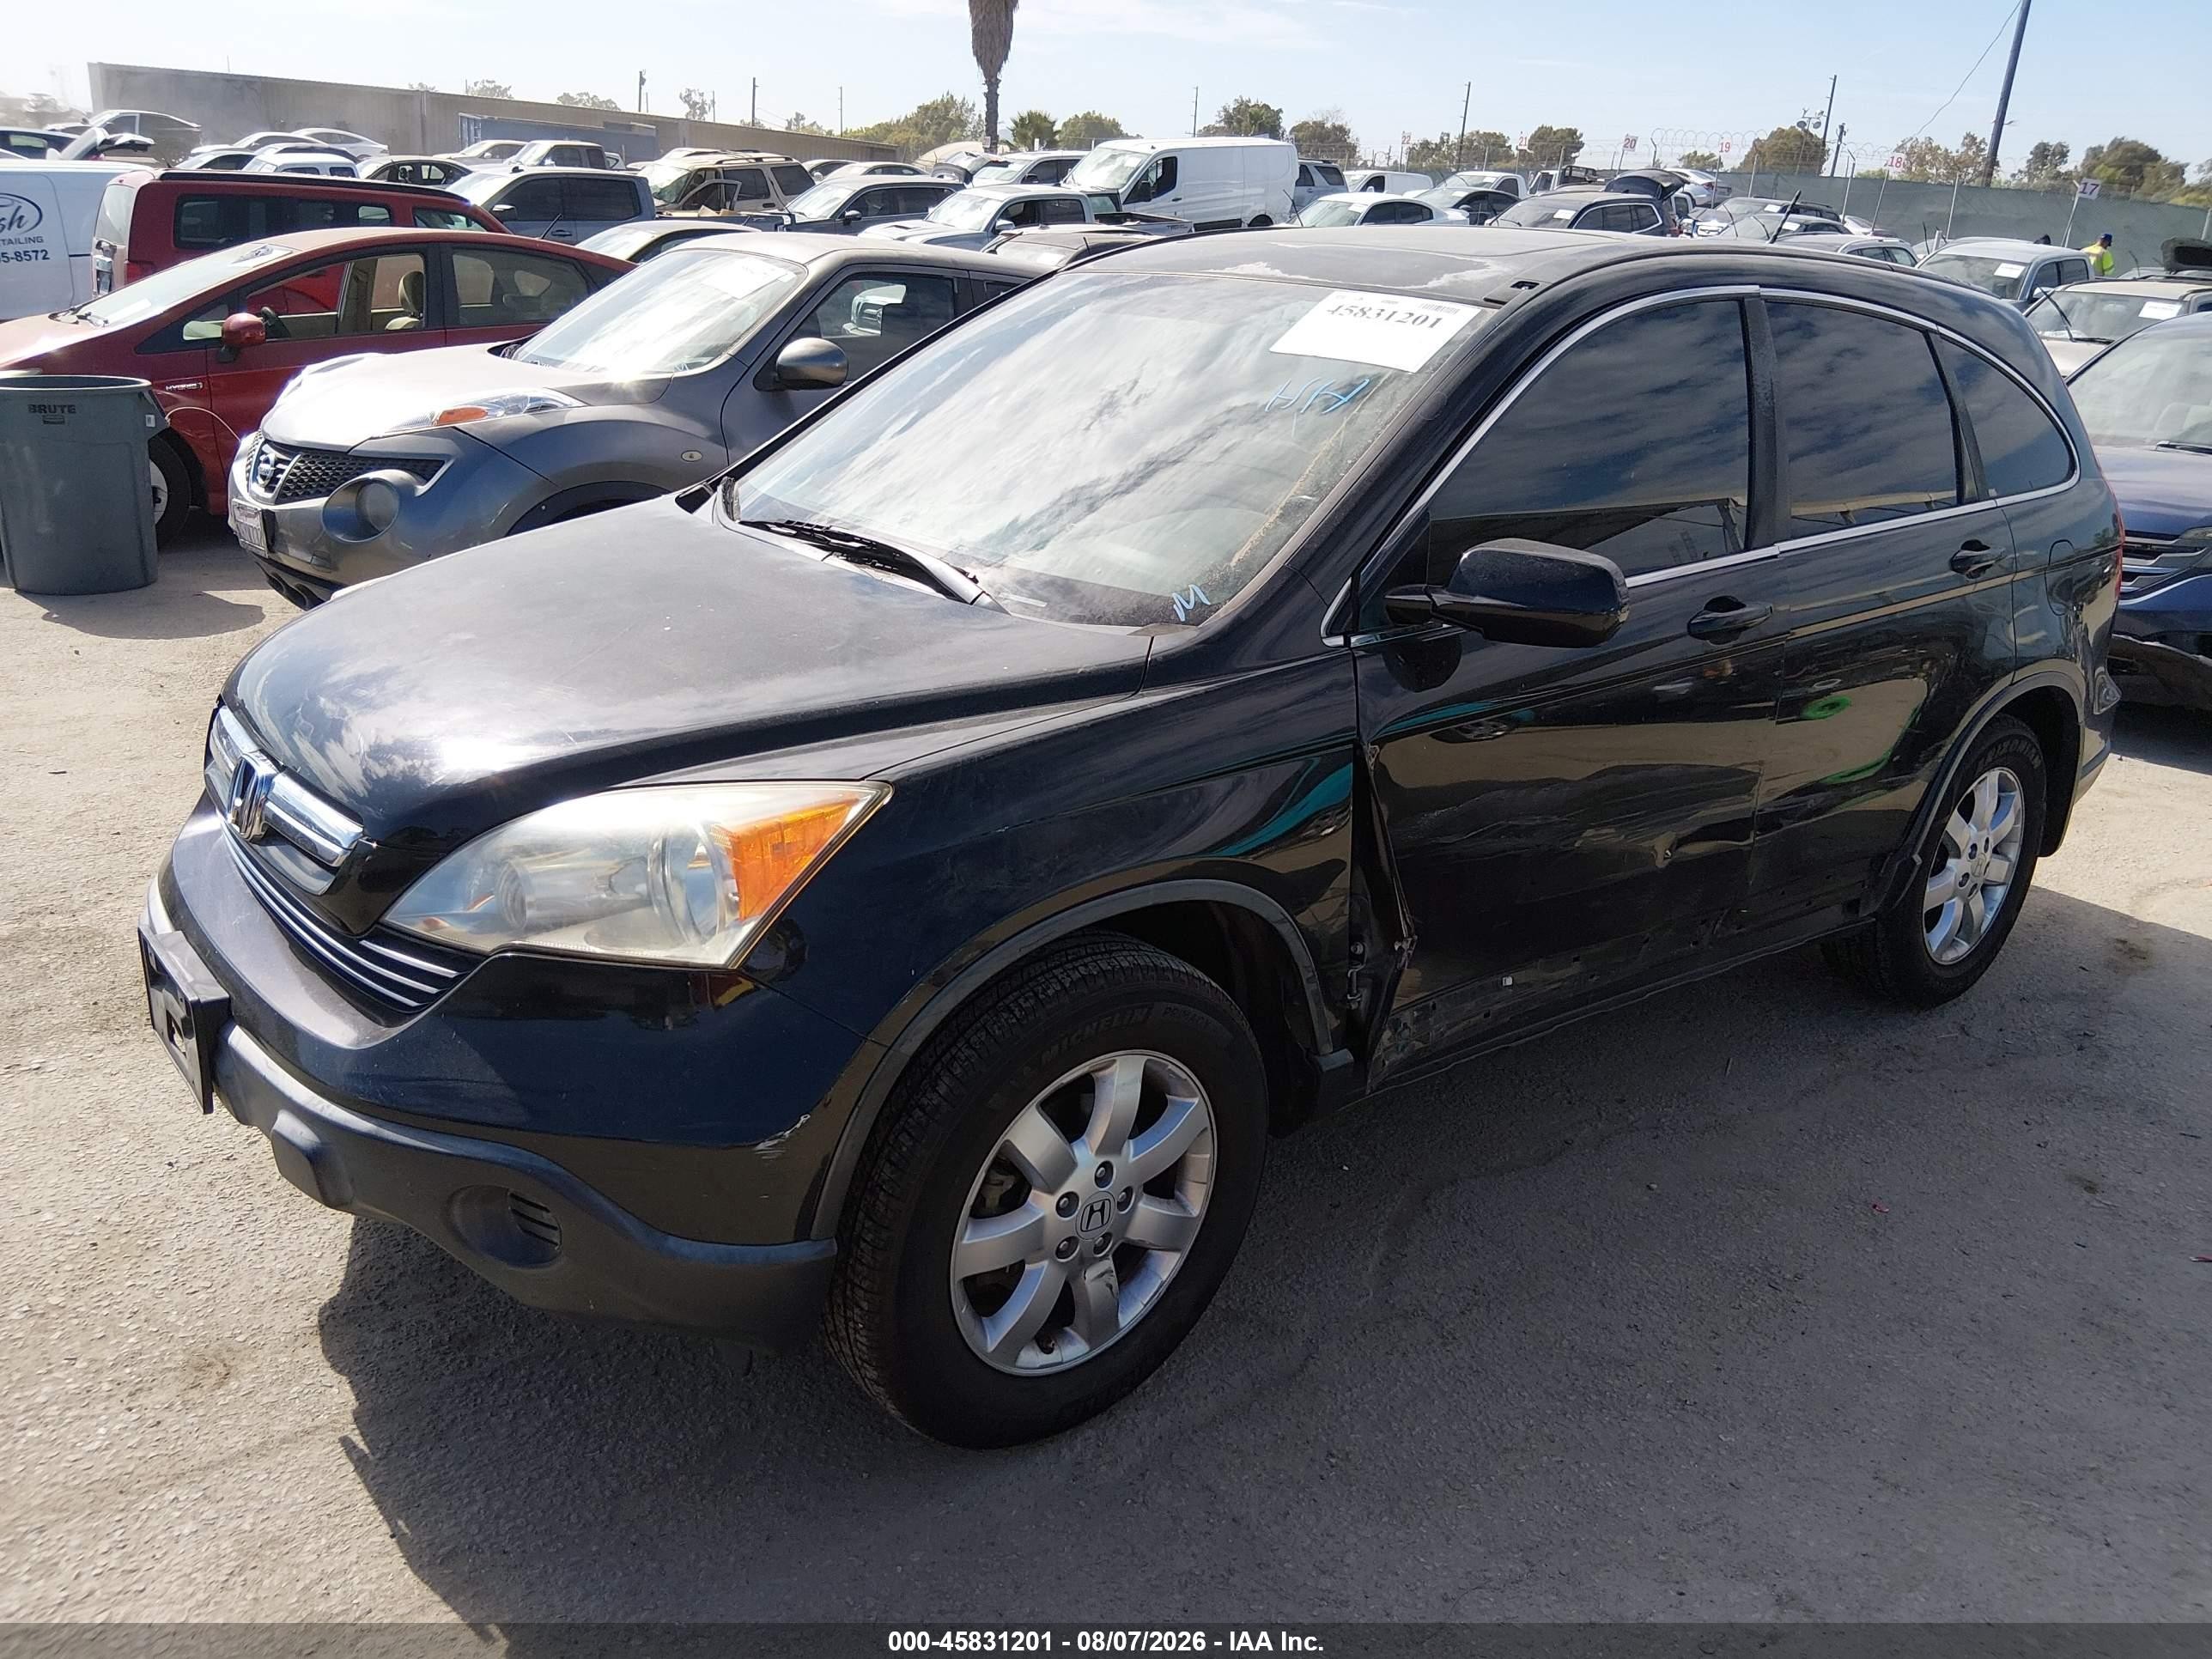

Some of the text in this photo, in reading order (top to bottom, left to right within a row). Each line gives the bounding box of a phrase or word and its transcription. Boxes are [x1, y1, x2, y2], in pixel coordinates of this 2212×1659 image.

[1401, 136, 1411, 144] 22
[1518, 137, 1528, 147] 21
[1623, 138, 1637, 149] 20
[1719, 142, 1730, 153] 19
[1888, 155, 1902, 168] 18
[2081, 181, 2099, 196] 17
[0, 250, 50, 263] 5-8572
[1327, 304, 1443, 329] 45831201
[27, 404, 76, 413] BRUTE
